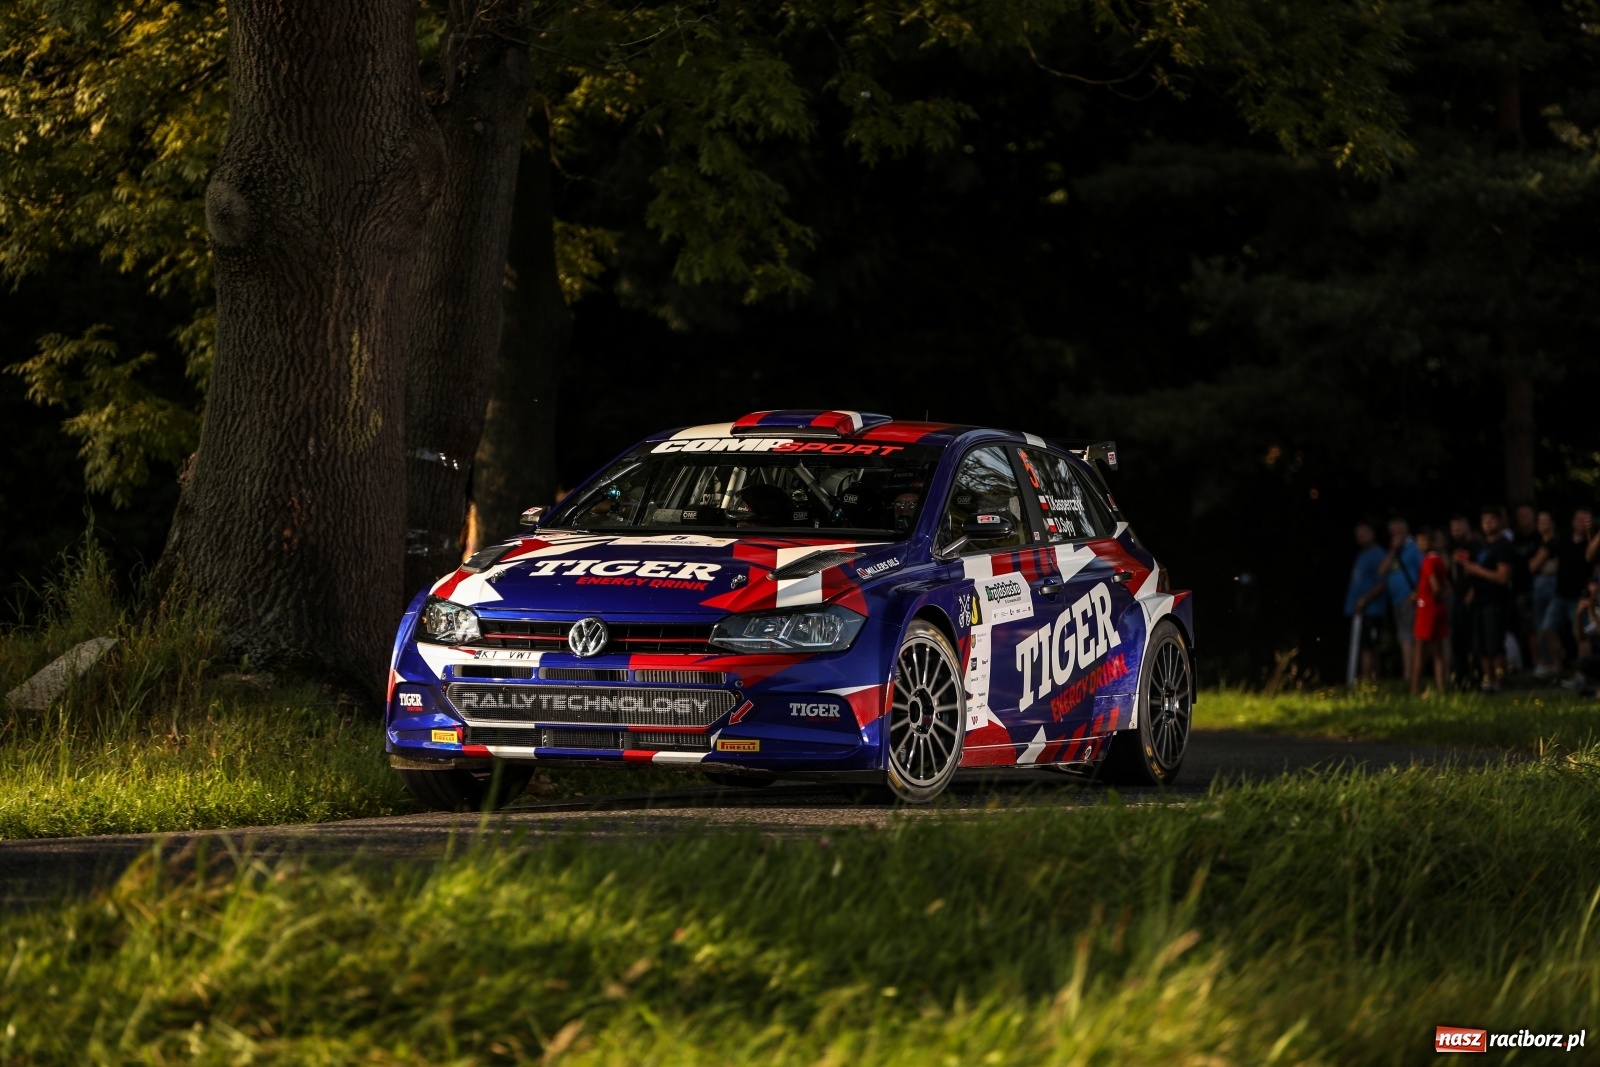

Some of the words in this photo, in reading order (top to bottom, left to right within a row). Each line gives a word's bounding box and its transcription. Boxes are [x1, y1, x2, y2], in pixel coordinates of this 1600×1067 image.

[528, 559, 722, 582] TIGER
[575, 576, 645, 587] ENERGY
[647, 578, 709, 592] DRINK
[1016, 582, 1122, 713] TIGER
[1050, 676, 1091, 723] ENERGY
[1089, 653, 1129, 695] DRINK
[398, 693, 423, 706] TIGER
[461, 692, 711, 713] RALLYTECHNOLOGY
[789, 702, 841, 718] TIGER
[434, 732, 455, 742] PIRELLI
[720, 741, 756, 751] PIRELLI
